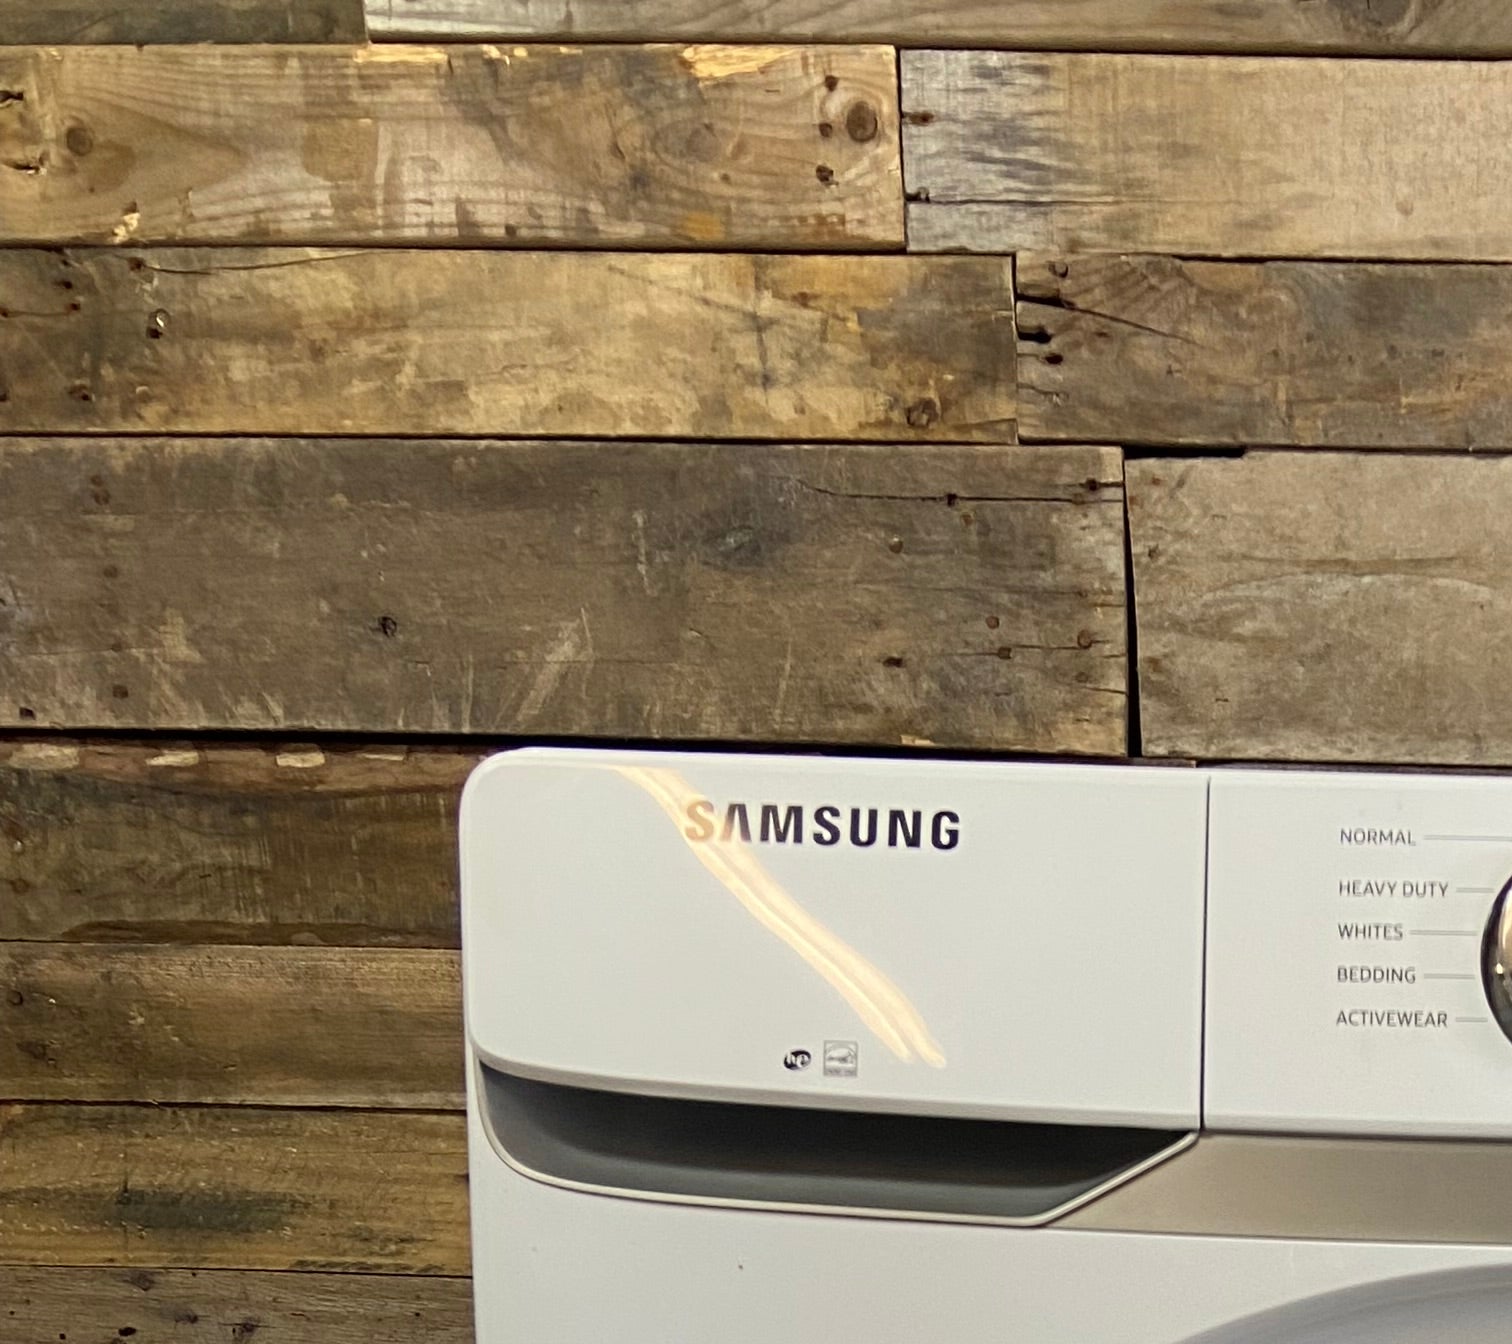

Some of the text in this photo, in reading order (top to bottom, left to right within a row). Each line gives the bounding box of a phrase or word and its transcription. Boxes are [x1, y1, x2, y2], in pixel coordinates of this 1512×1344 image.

[684, 799, 961, 851] SAMSUNG
[1339, 828, 1417, 846] NORMAL
[1338, 879, 1449, 898] HEAVY DUTY
[1337, 922, 1404, 941] WHITES
[1336, 964, 1417, 985] BEDDING
[1335, 1008, 1449, 1028] ACTIVEWEAR
